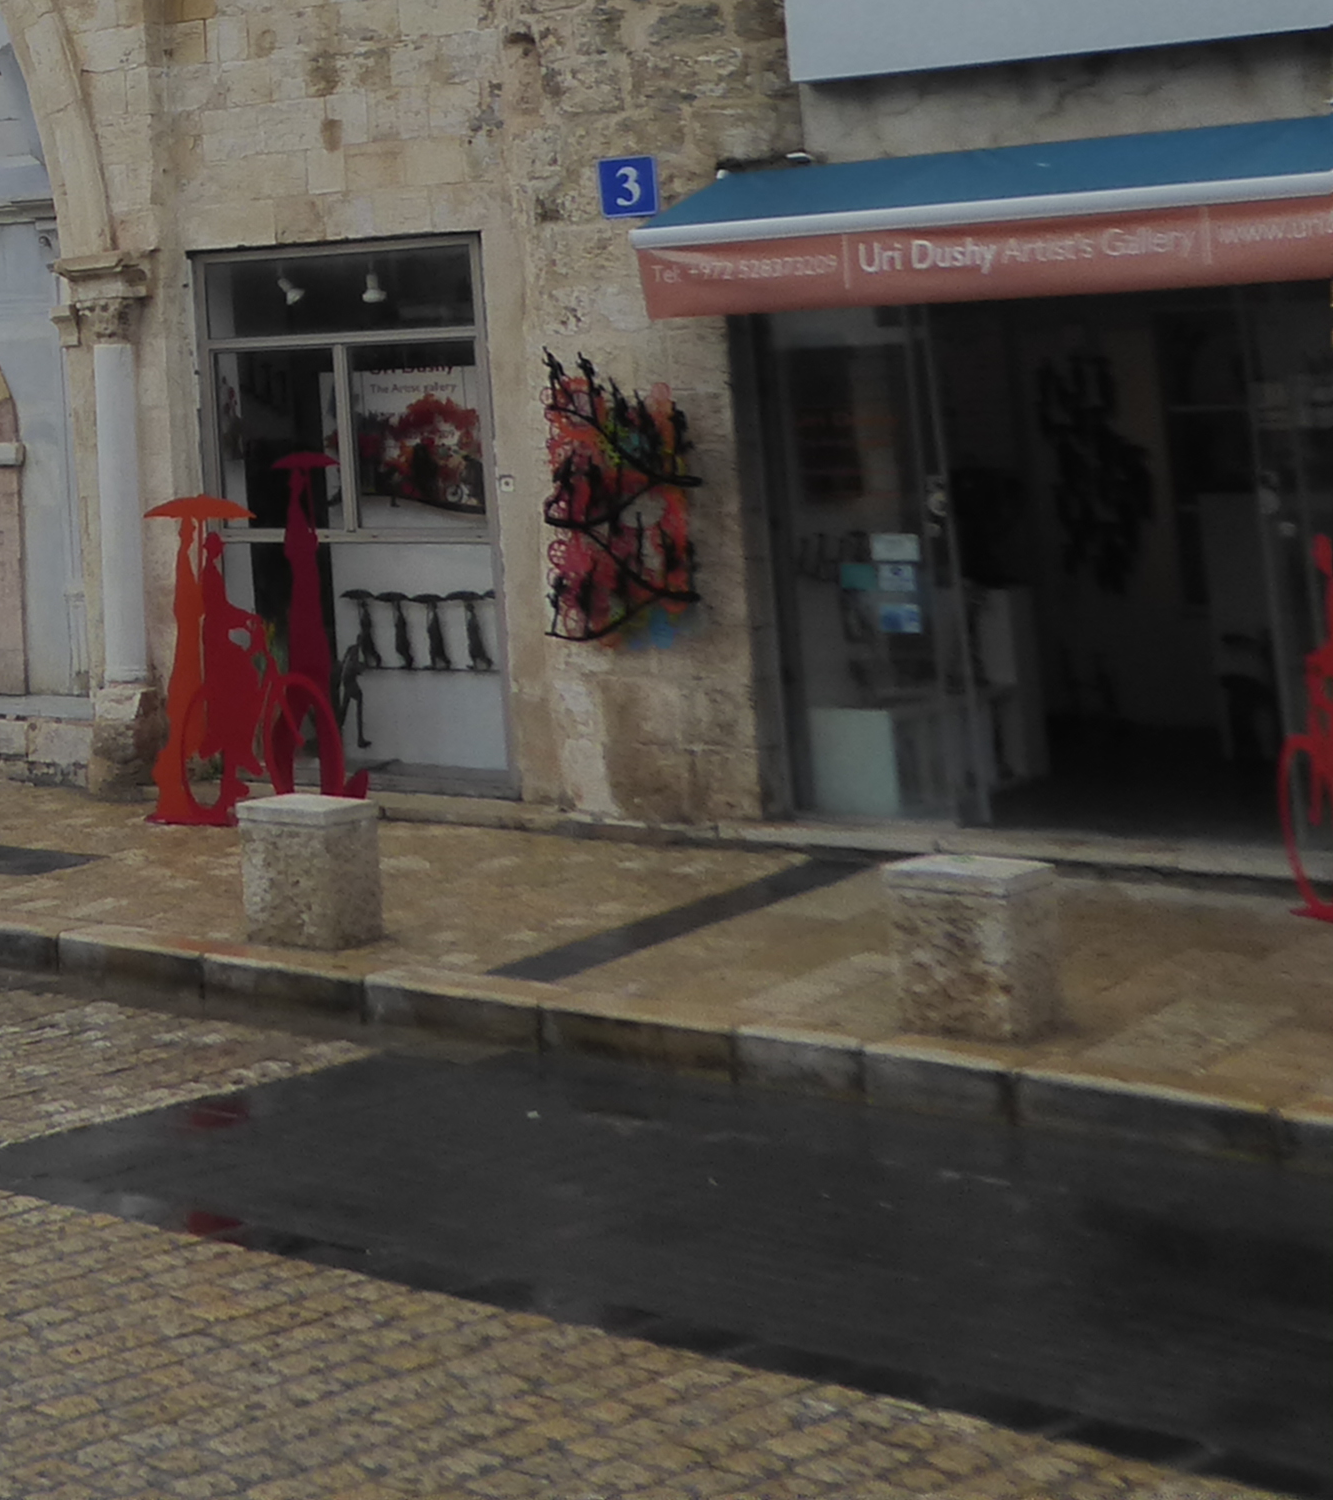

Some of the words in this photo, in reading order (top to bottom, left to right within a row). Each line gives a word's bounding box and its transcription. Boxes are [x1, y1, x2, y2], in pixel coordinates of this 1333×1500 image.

[616, 166, 641, 206] 3
[859, 241, 903, 273] Uri
[911, 237, 996, 274] Dushy
[1001, 233, 1096, 264] Artist's
[1101, 227, 1196, 259] Gallery
[370, 383, 389, 394] The
